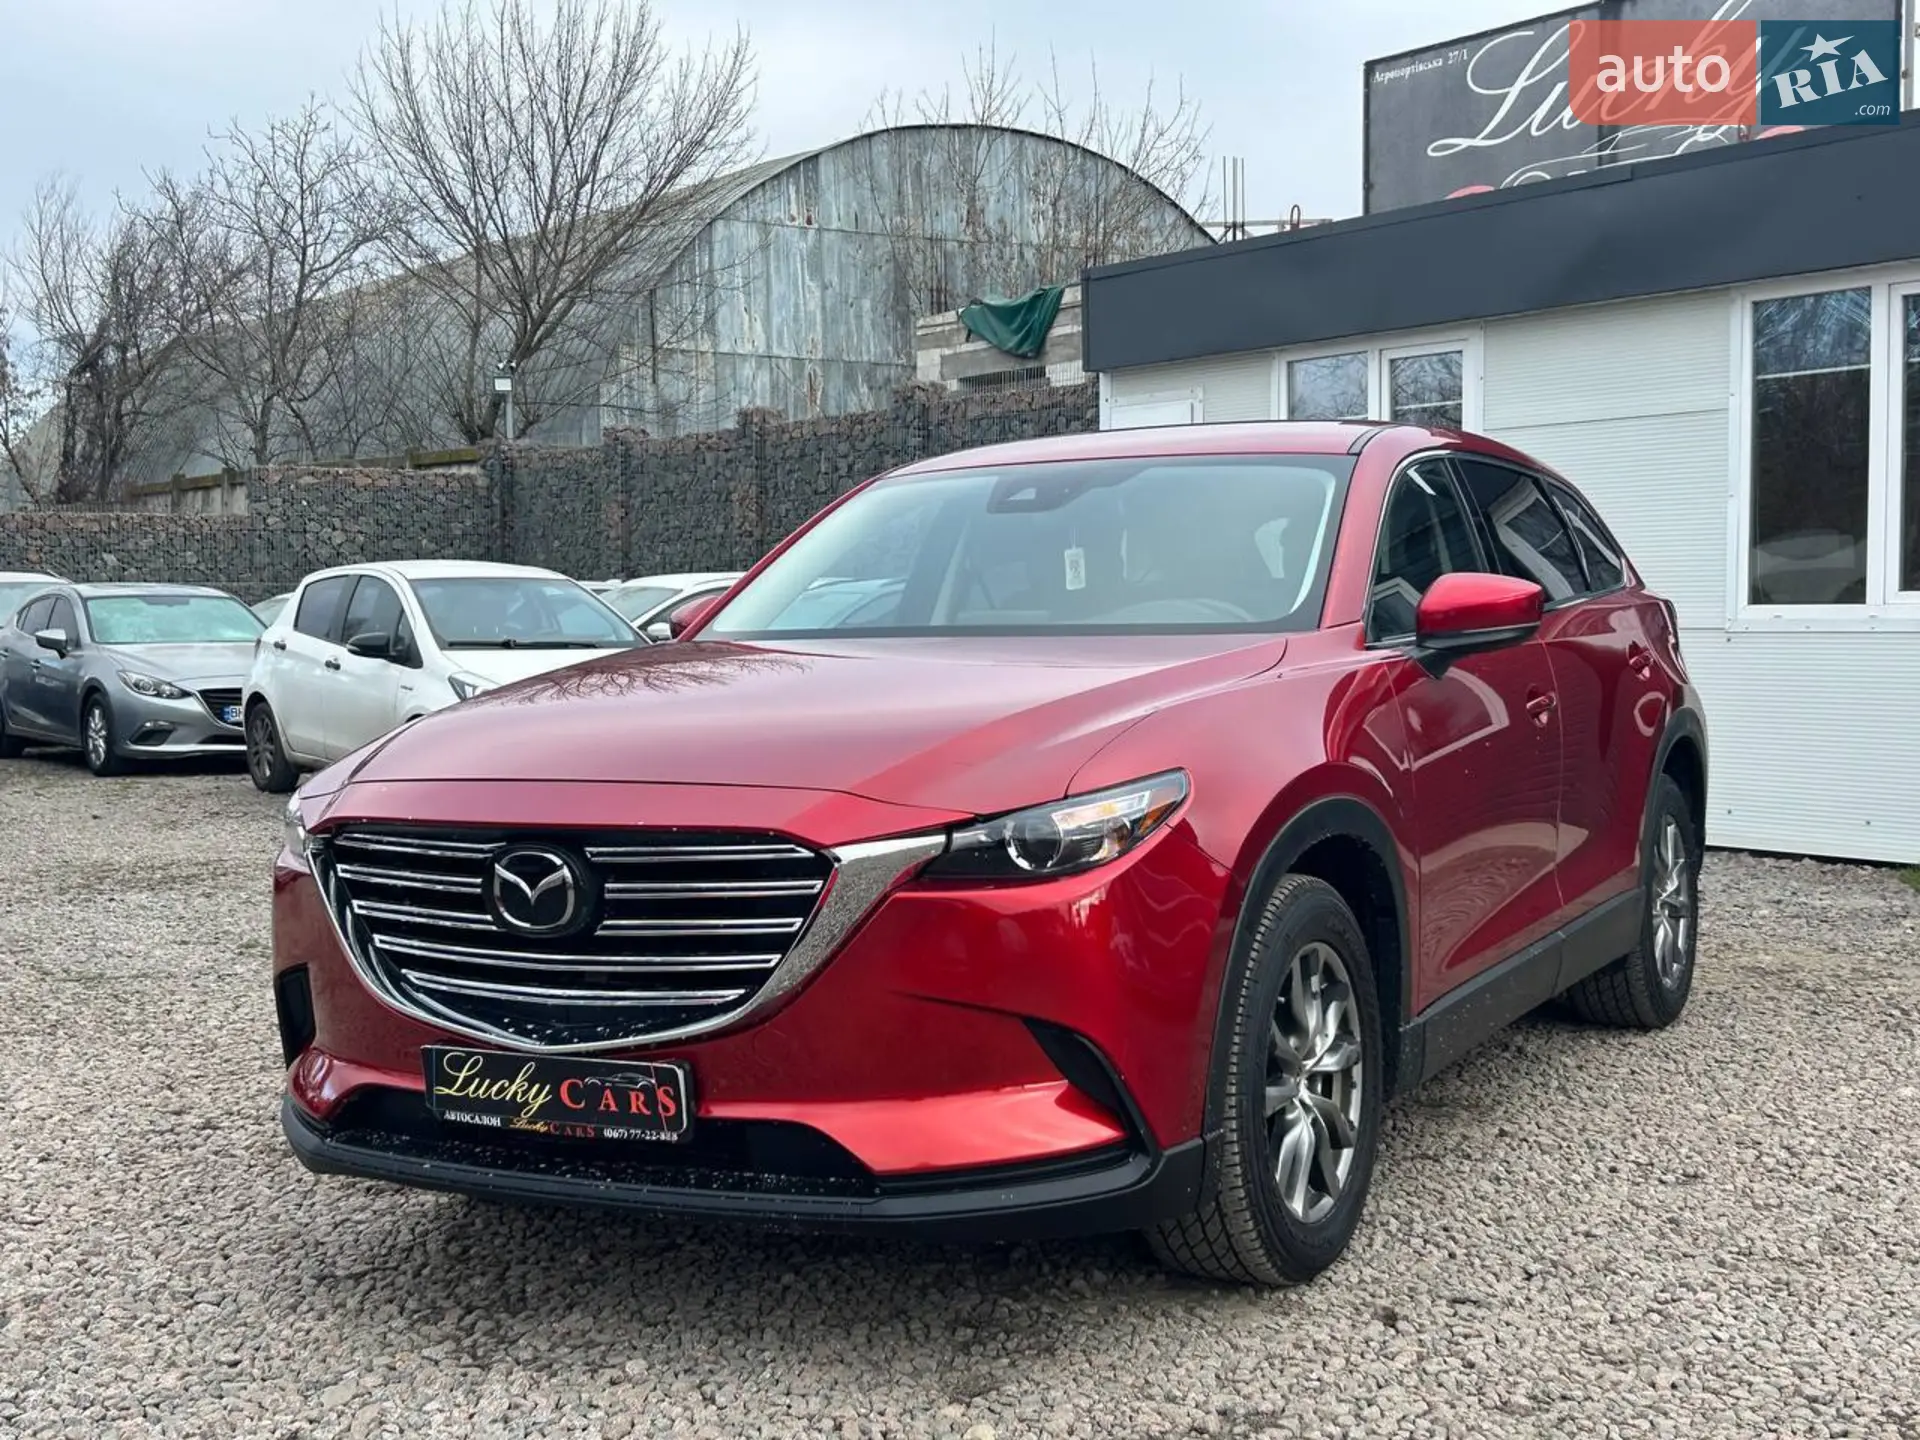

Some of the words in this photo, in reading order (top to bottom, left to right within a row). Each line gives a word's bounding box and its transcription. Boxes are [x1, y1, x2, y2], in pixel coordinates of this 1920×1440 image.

[1447, 48, 1469, 65] 27/1
[434, 1052, 552, 1118] Lucky
[559, 1079, 678, 1117] CARS
[443, 1109, 501, 1127] АВТОСАЛОН
[509, 1117, 549, 1133] Lucky
[603, 1127, 628, 1140] (067)
